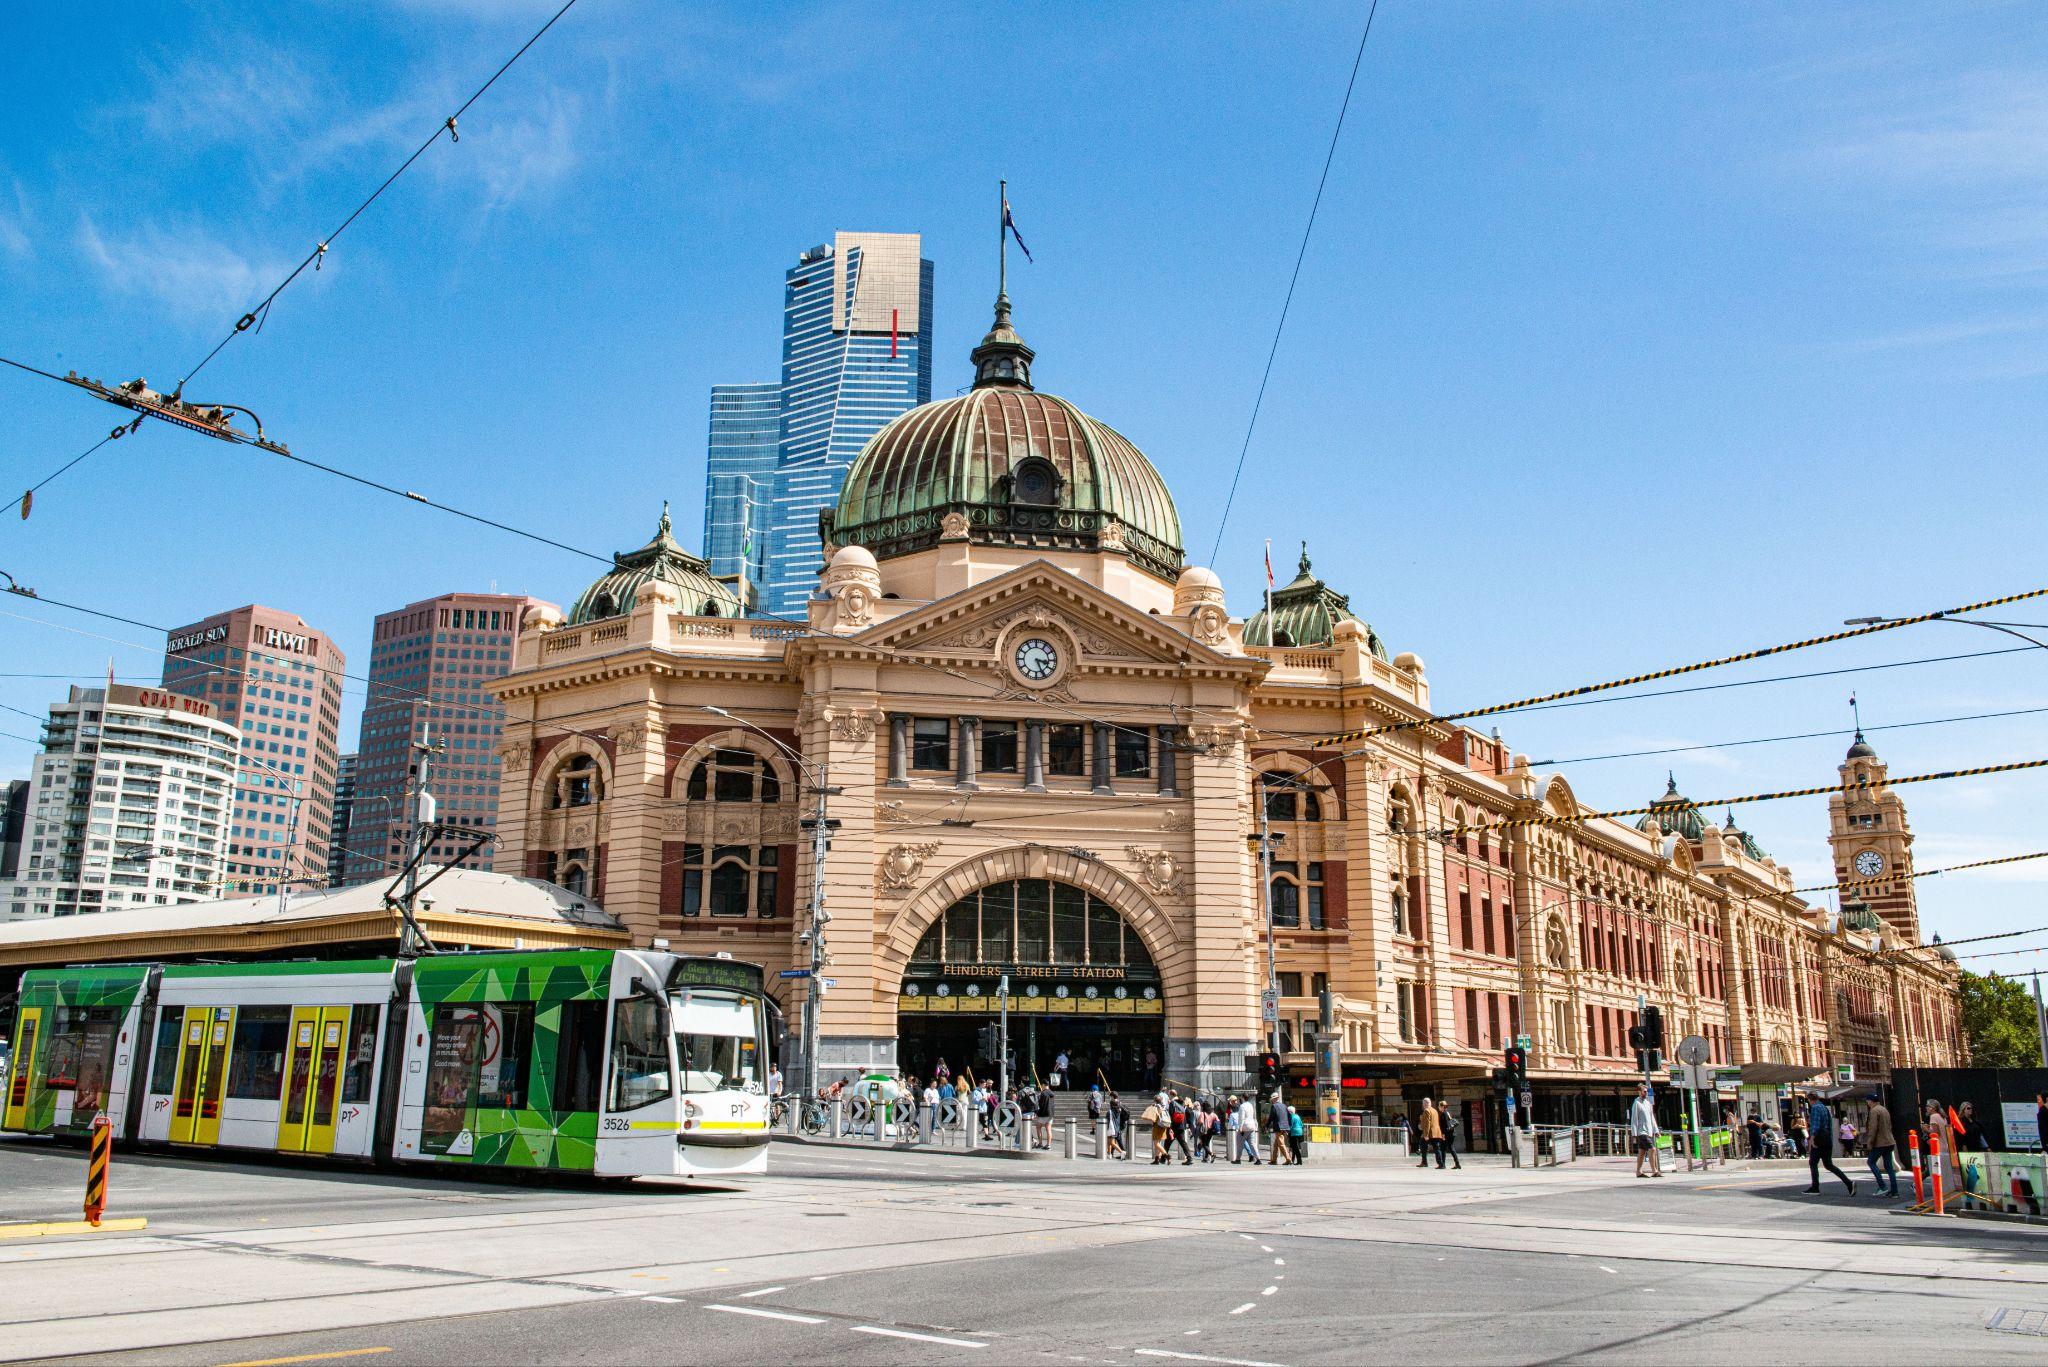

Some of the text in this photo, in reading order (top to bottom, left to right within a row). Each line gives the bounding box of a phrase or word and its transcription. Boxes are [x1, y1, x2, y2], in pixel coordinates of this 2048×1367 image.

[206, 625, 227, 642] SUN
[267, 629, 307, 651] HWT
[139, 691, 210, 717] QUAY WEST
[687, 963, 708, 974] Glen
[712, 966, 728, 976] Iris
[944, 965, 1124, 978] FLINDERS STREET STATION
[682, 973, 701, 984] City
[715, 976, 736, 986] High
[604, 1118, 630, 1131] 3526
